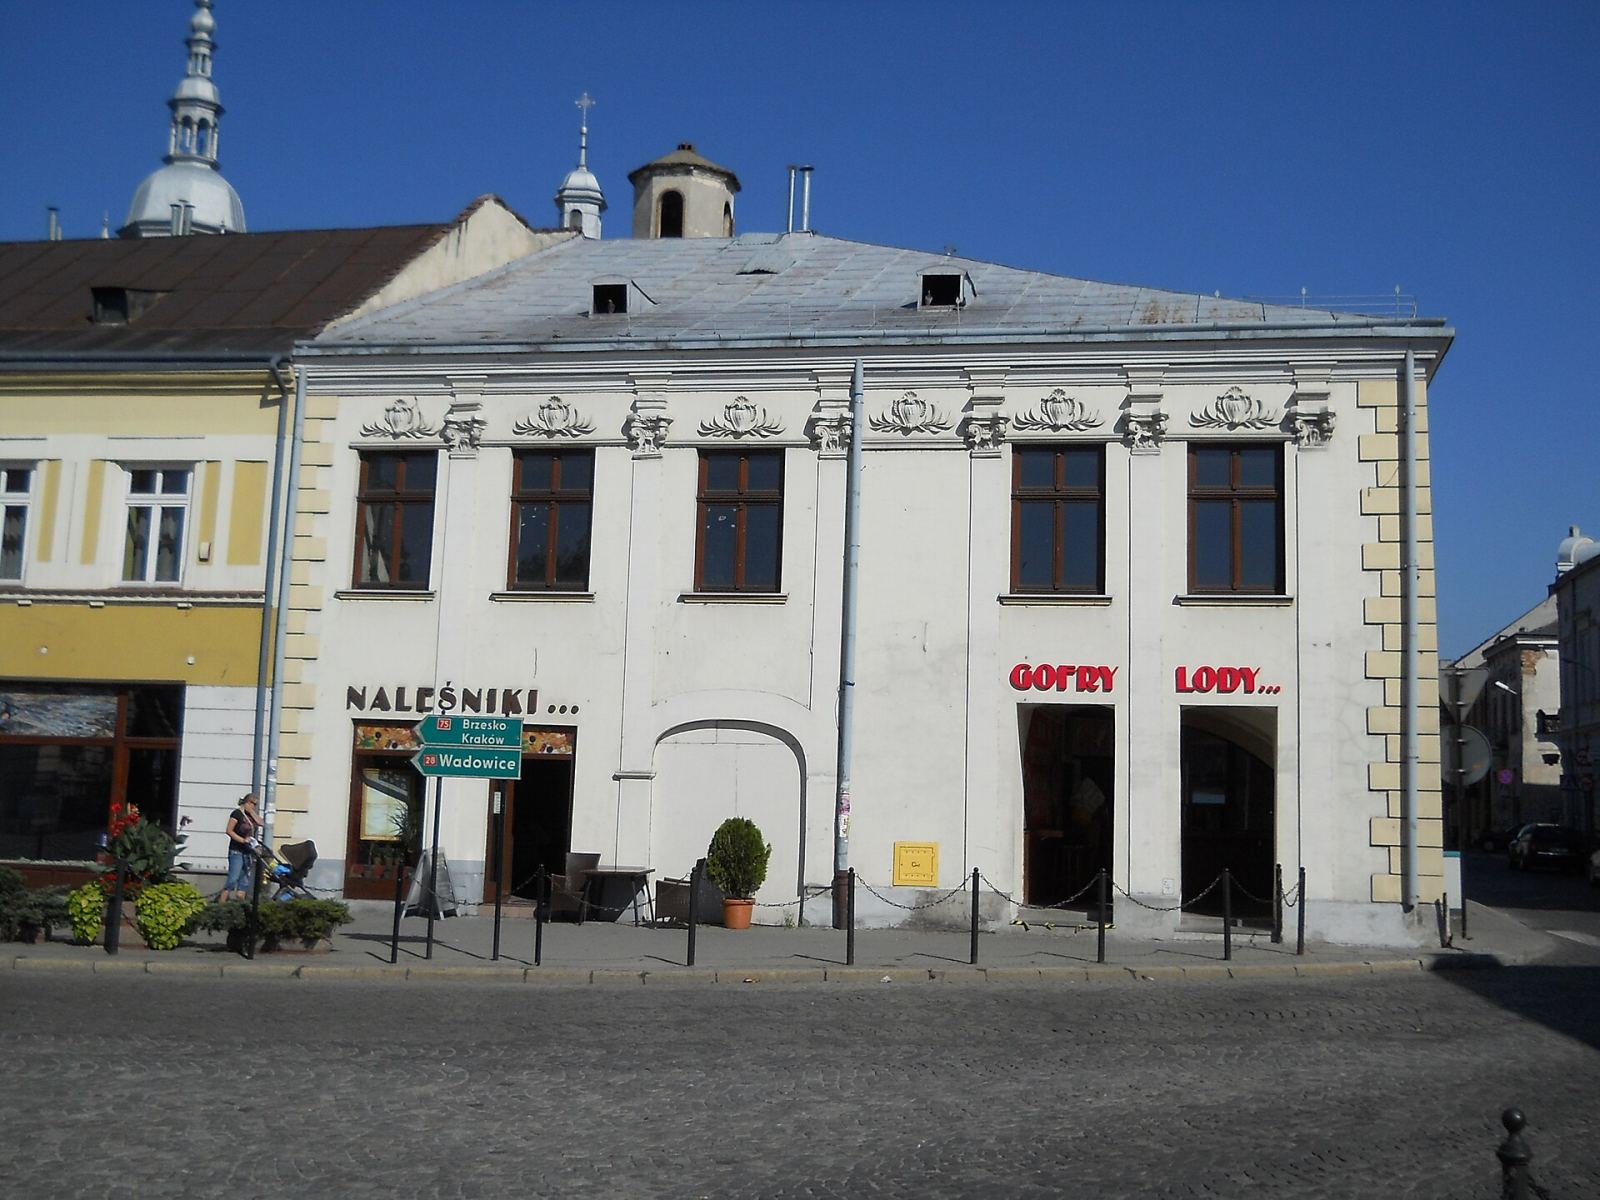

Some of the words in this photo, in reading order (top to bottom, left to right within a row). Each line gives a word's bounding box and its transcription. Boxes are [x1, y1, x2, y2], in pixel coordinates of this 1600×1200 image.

[1009, 663, 1119, 692] GOFRY
[439, 720, 449, 729] 75
[462, 719, 507, 731] Brzesko
[461, 733, 505, 745] Kraków
[424, 756, 437, 765] 28
[439, 753, 516, 770] Wadowice
